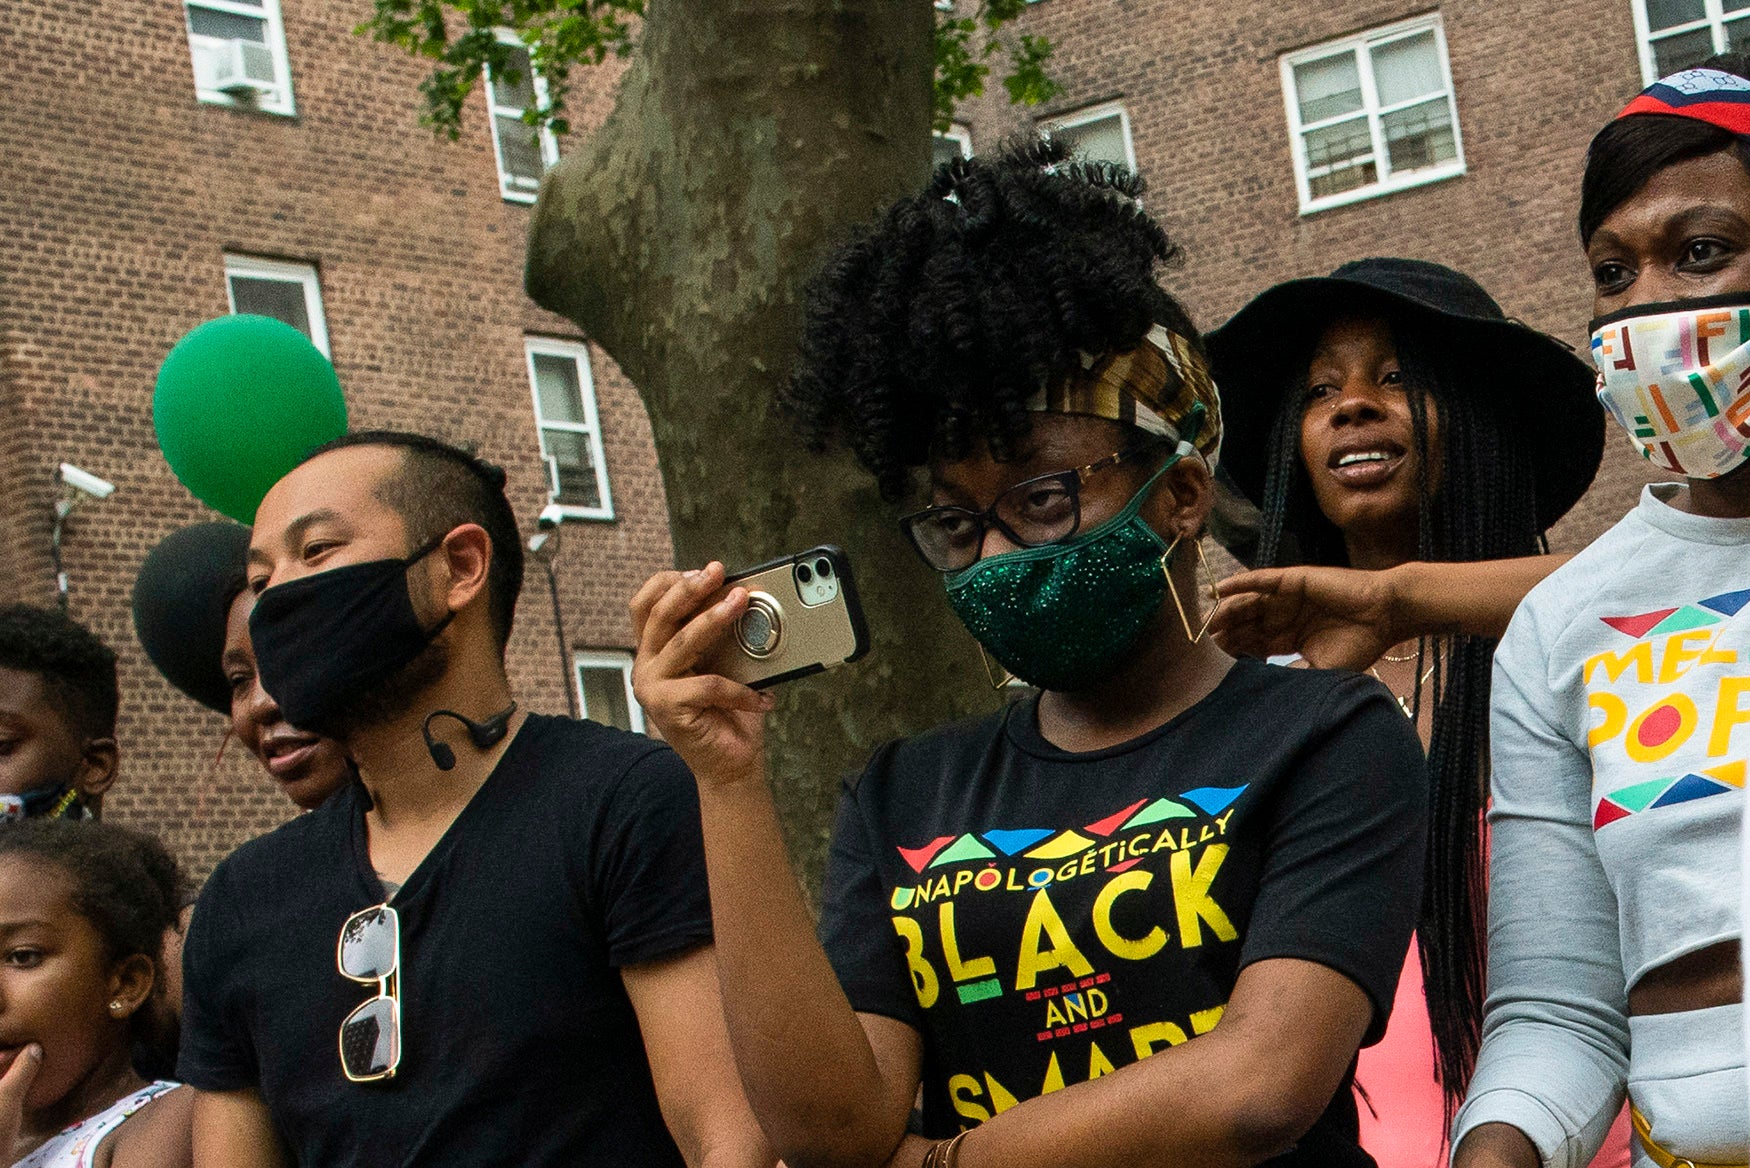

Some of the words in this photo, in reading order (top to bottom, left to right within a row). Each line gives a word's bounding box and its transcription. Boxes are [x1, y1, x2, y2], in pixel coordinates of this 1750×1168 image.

[890, 808, 1235, 911] UNAPOLOGETICALLY
[892, 842, 1240, 1009] BLACK
[1046, 987, 1109, 1029] AND
[948, 1003, 1228, 1136] SMA
